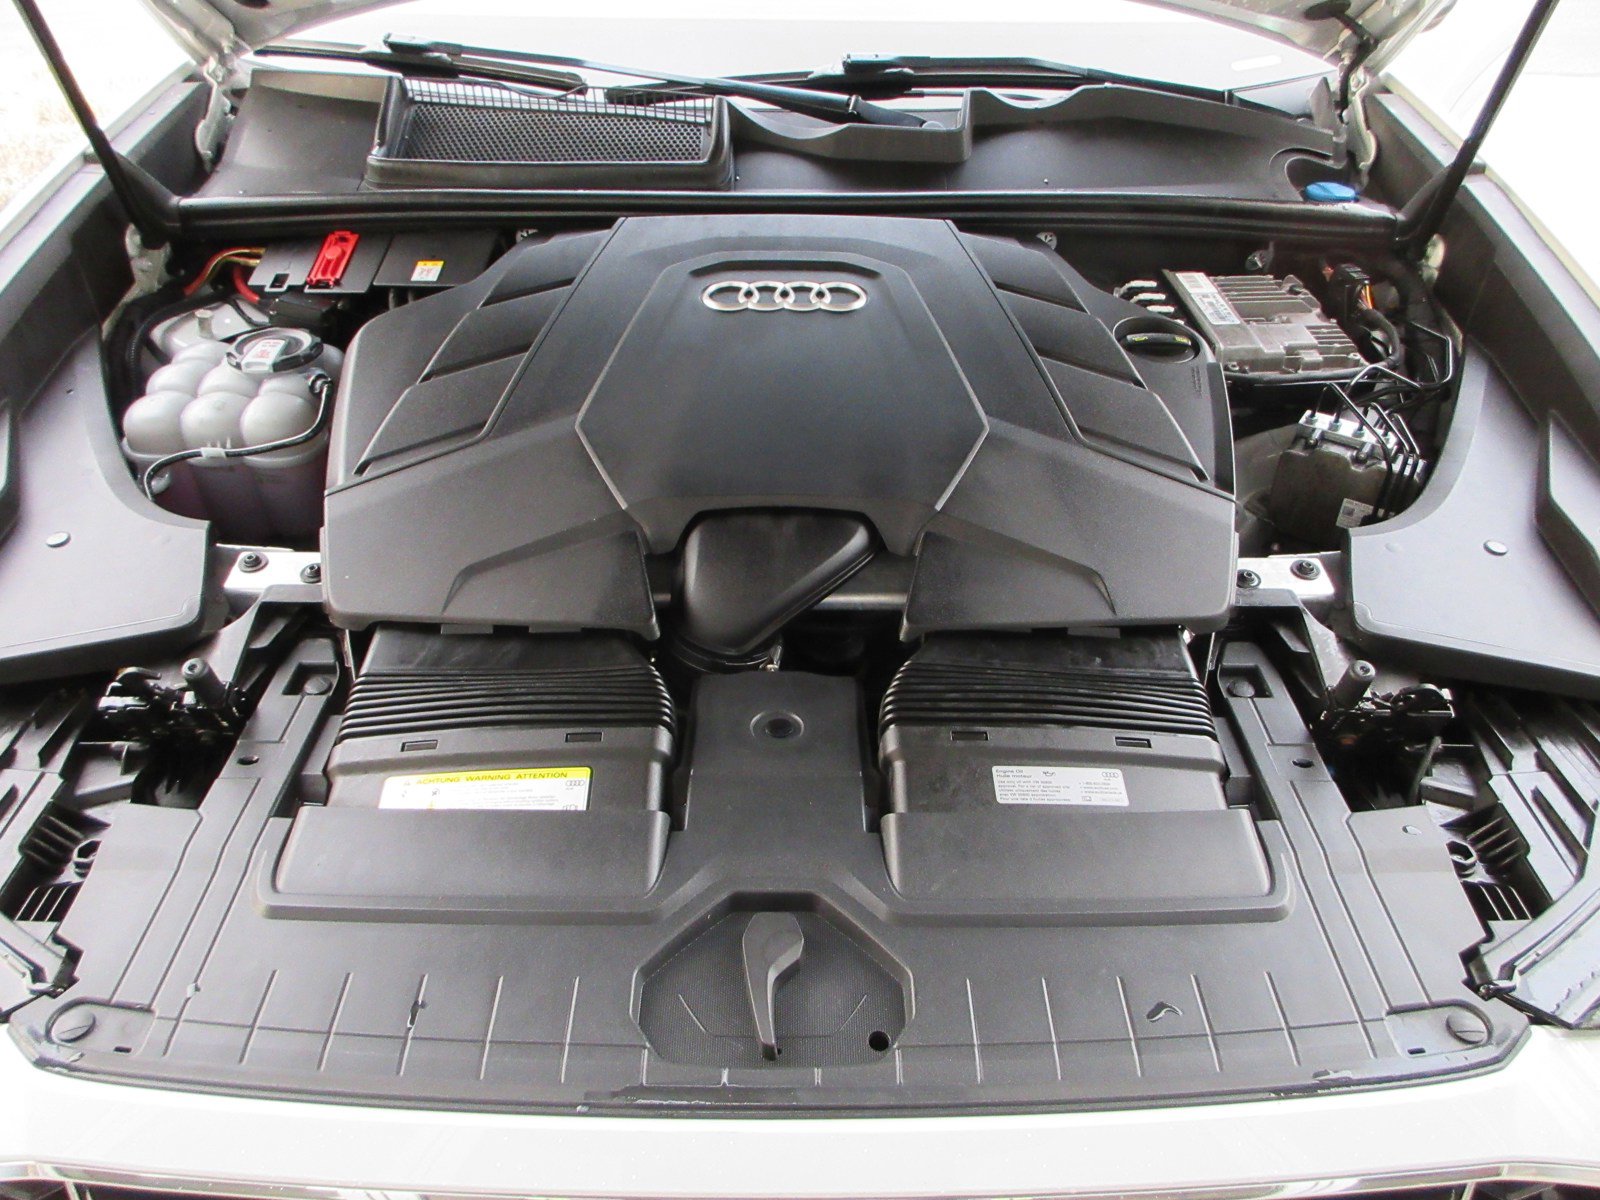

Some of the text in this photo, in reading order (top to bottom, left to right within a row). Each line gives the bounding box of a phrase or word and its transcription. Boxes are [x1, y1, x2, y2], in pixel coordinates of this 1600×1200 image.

[416, 771, 568, 785] ACHTUNG WARNING ATTENTION
